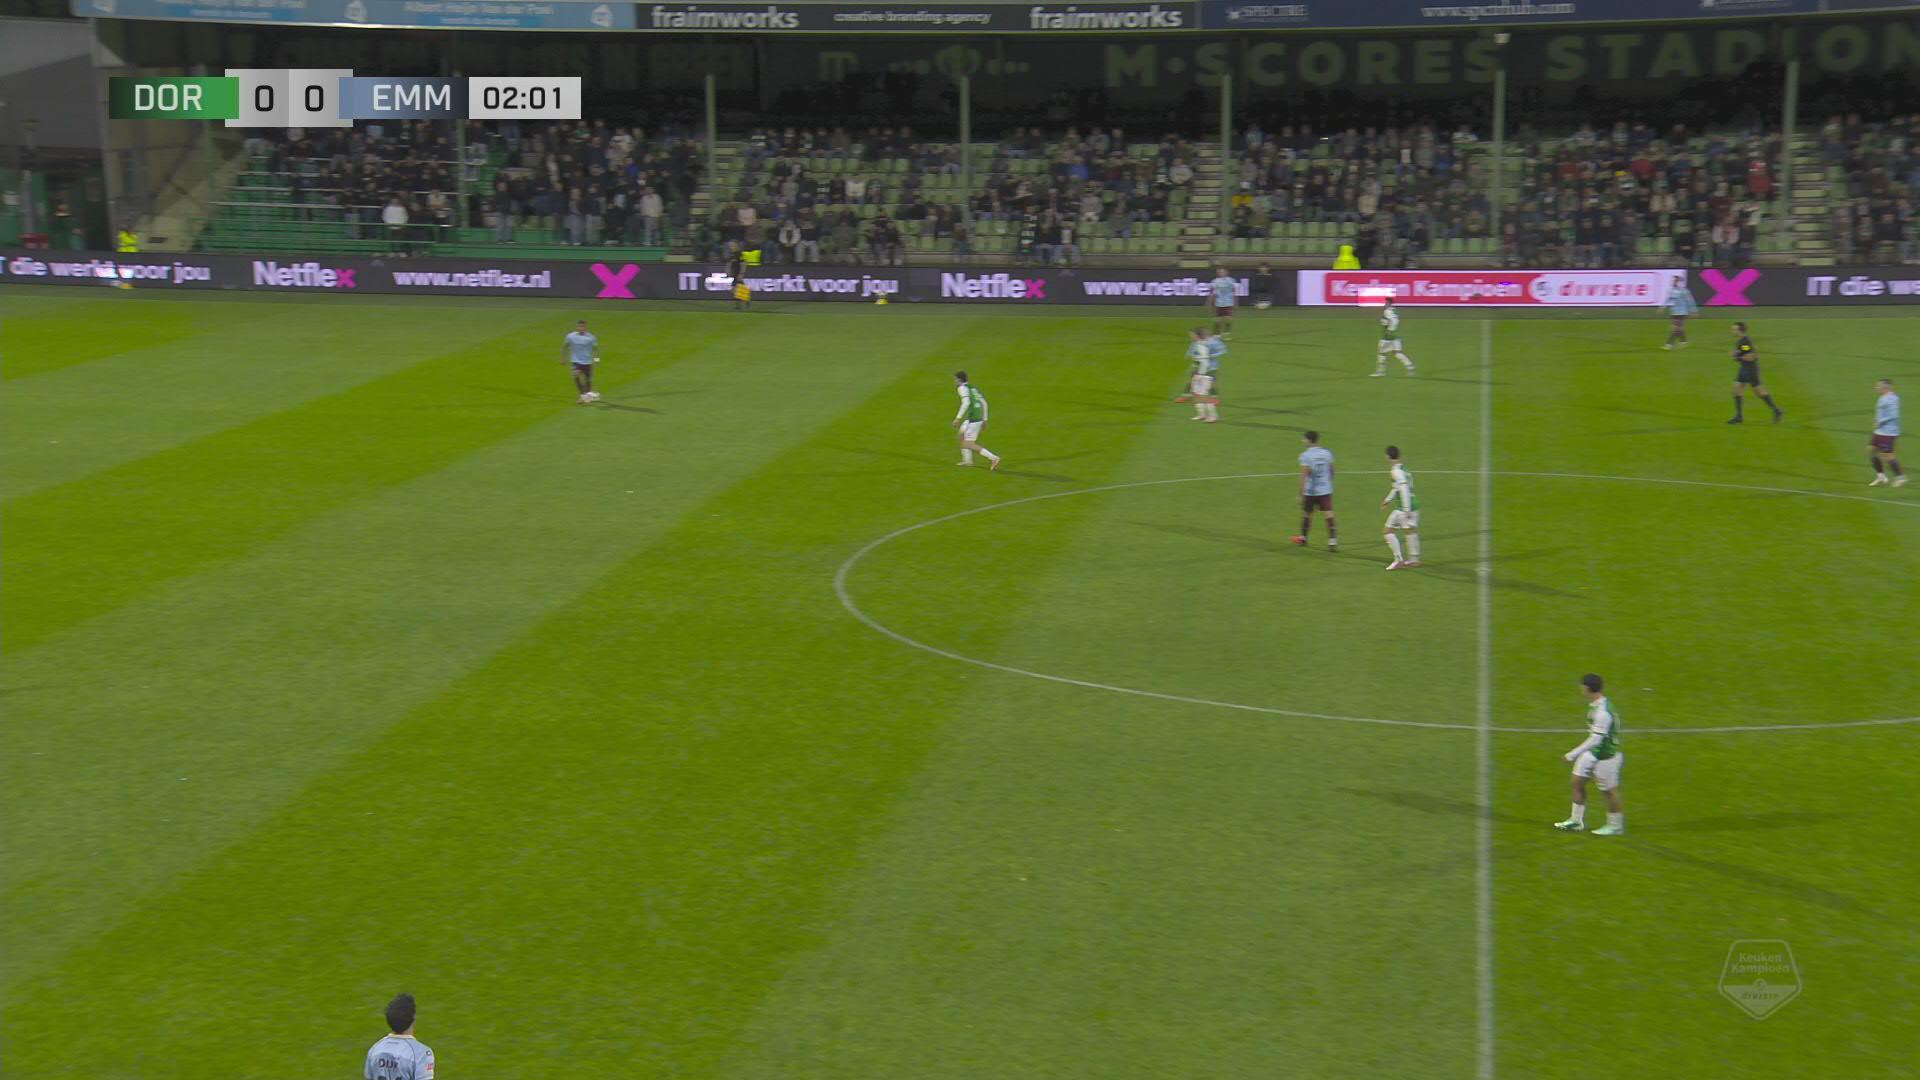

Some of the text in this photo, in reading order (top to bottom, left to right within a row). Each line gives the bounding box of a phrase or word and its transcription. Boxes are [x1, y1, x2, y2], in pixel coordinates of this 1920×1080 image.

[651, 5, 799, 28] fraimworks
[946, 13, 992, 24] agency
[1030, 4, 1183, 29] fraimworks
[1545, 23, 1920, 81] STADION
[9, 256, 48, 276] die
[118, 264, 171, 280] voor
[173, 262, 211, 284] jou
[252, 261, 357, 288] Netflex
[392, 269, 552, 288] www.netflex.nl
[678, 272, 702, 291] IT
[743, 273, 806, 293] werkt
[808, 278, 860, 293] voor
[862, 275, 899, 298] jou
[940, 272, 1047, 299] Netflex
[1806, 275, 1838, 297] IT
[1839, 275, 1885, 296] die
